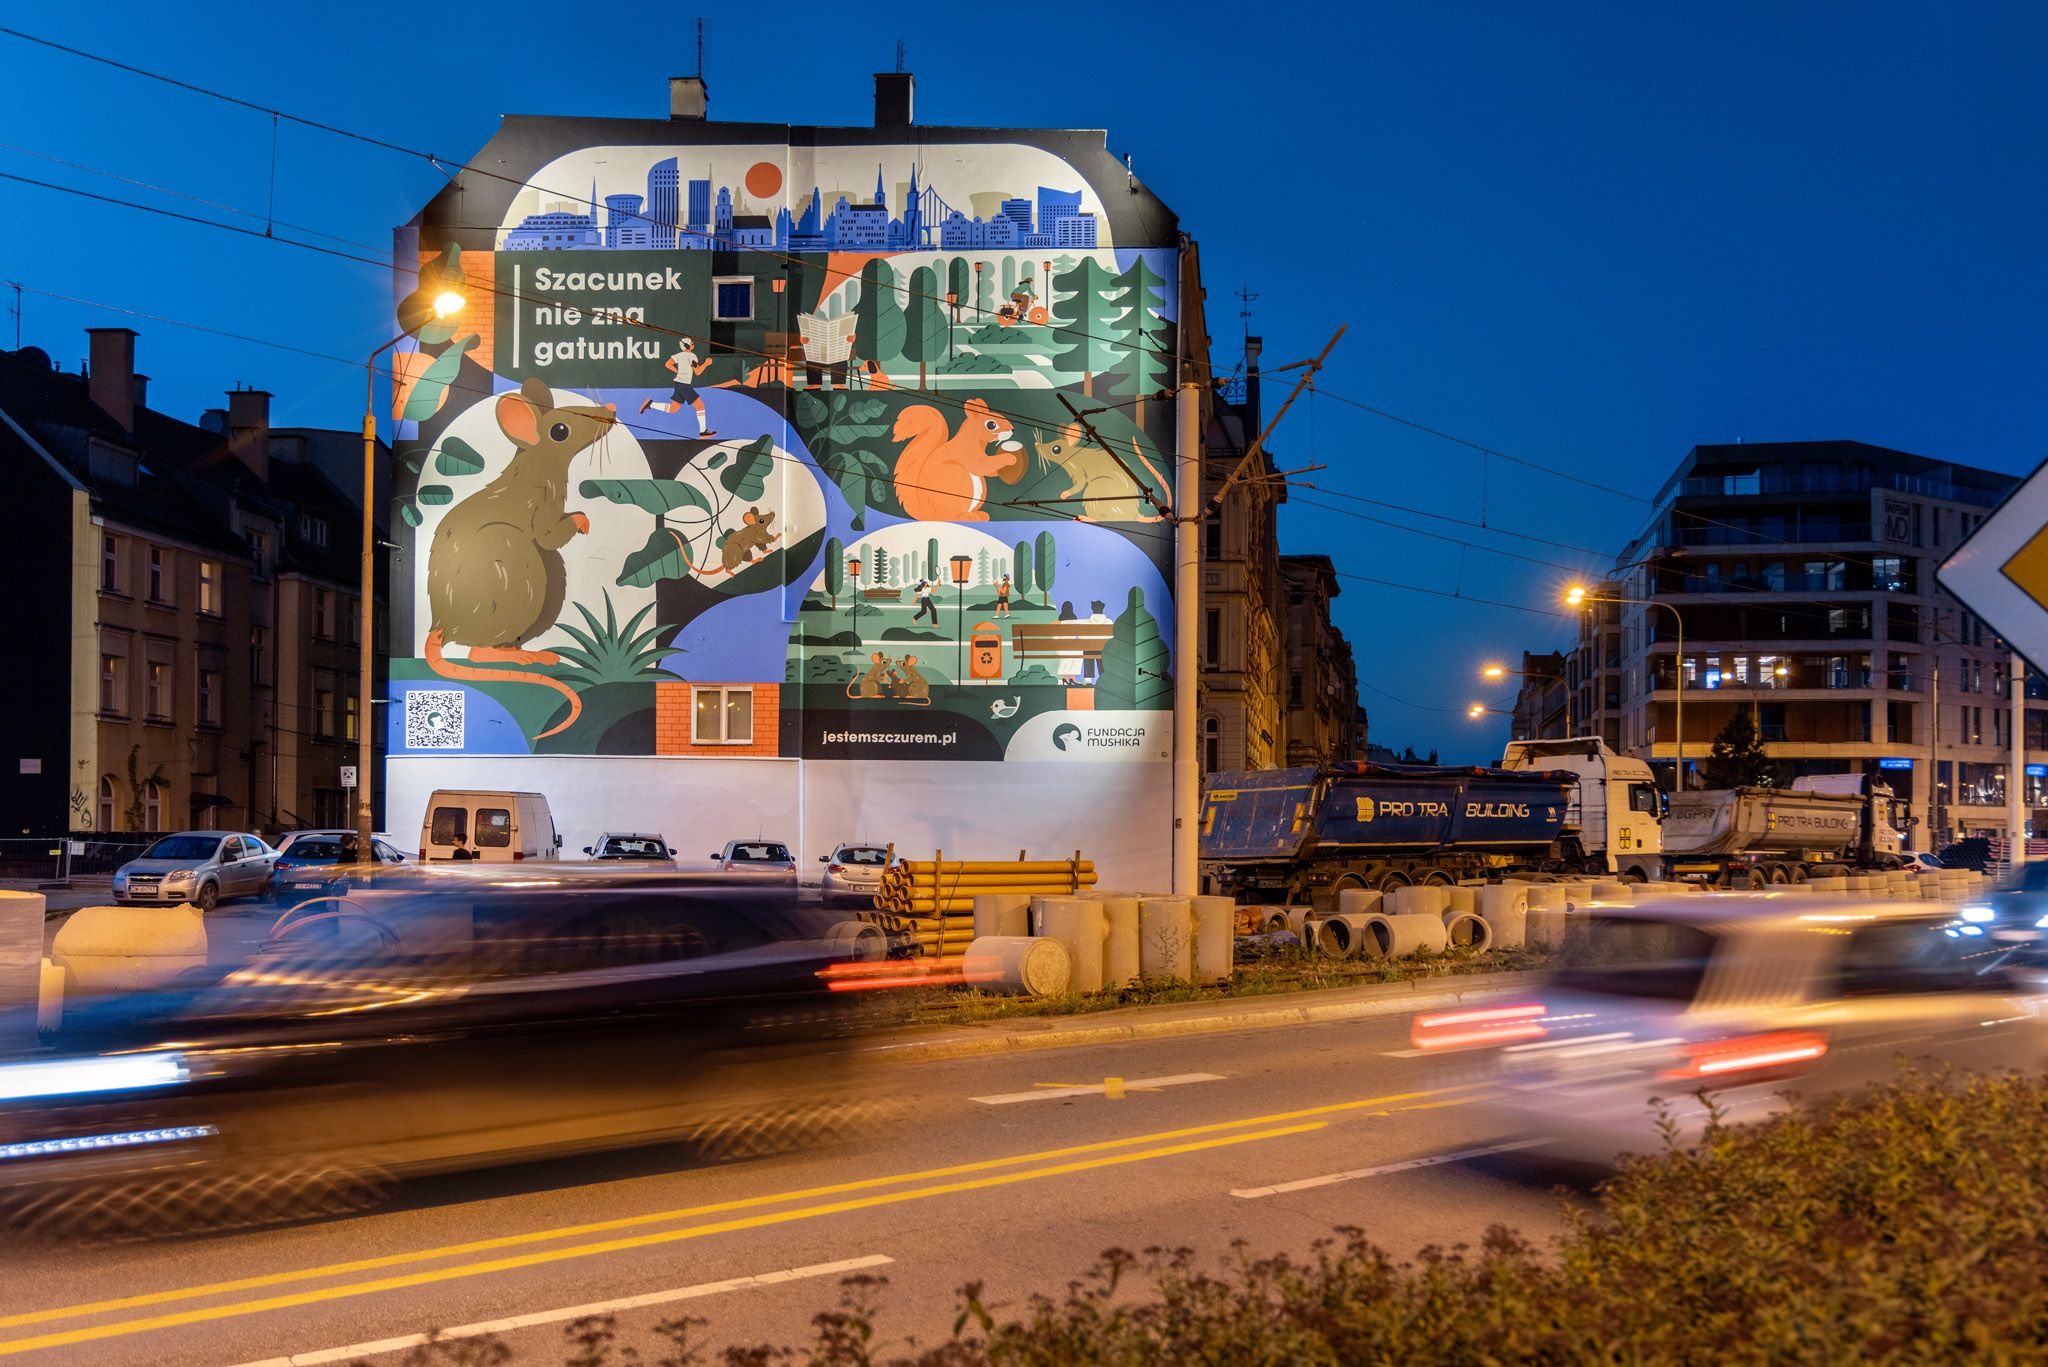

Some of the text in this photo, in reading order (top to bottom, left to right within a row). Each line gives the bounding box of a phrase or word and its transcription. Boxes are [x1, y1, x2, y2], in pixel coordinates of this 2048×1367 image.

[534, 266, 683, 292] Szacunek
[534, 302, 645, 326] nie zna
[534, 336, 661, 367] gatunku
[822, 730, 958, 746] jestemszczurem.pl
[1087, 727, 1146, 737] FUNDACJA
[1087, 737, 1140, 747] MUSHIKA
[1379, 801, 1530, 818] PRO TRA BUILDING
[1778, 815, 1848, 829] PRO TRA BUILDING
